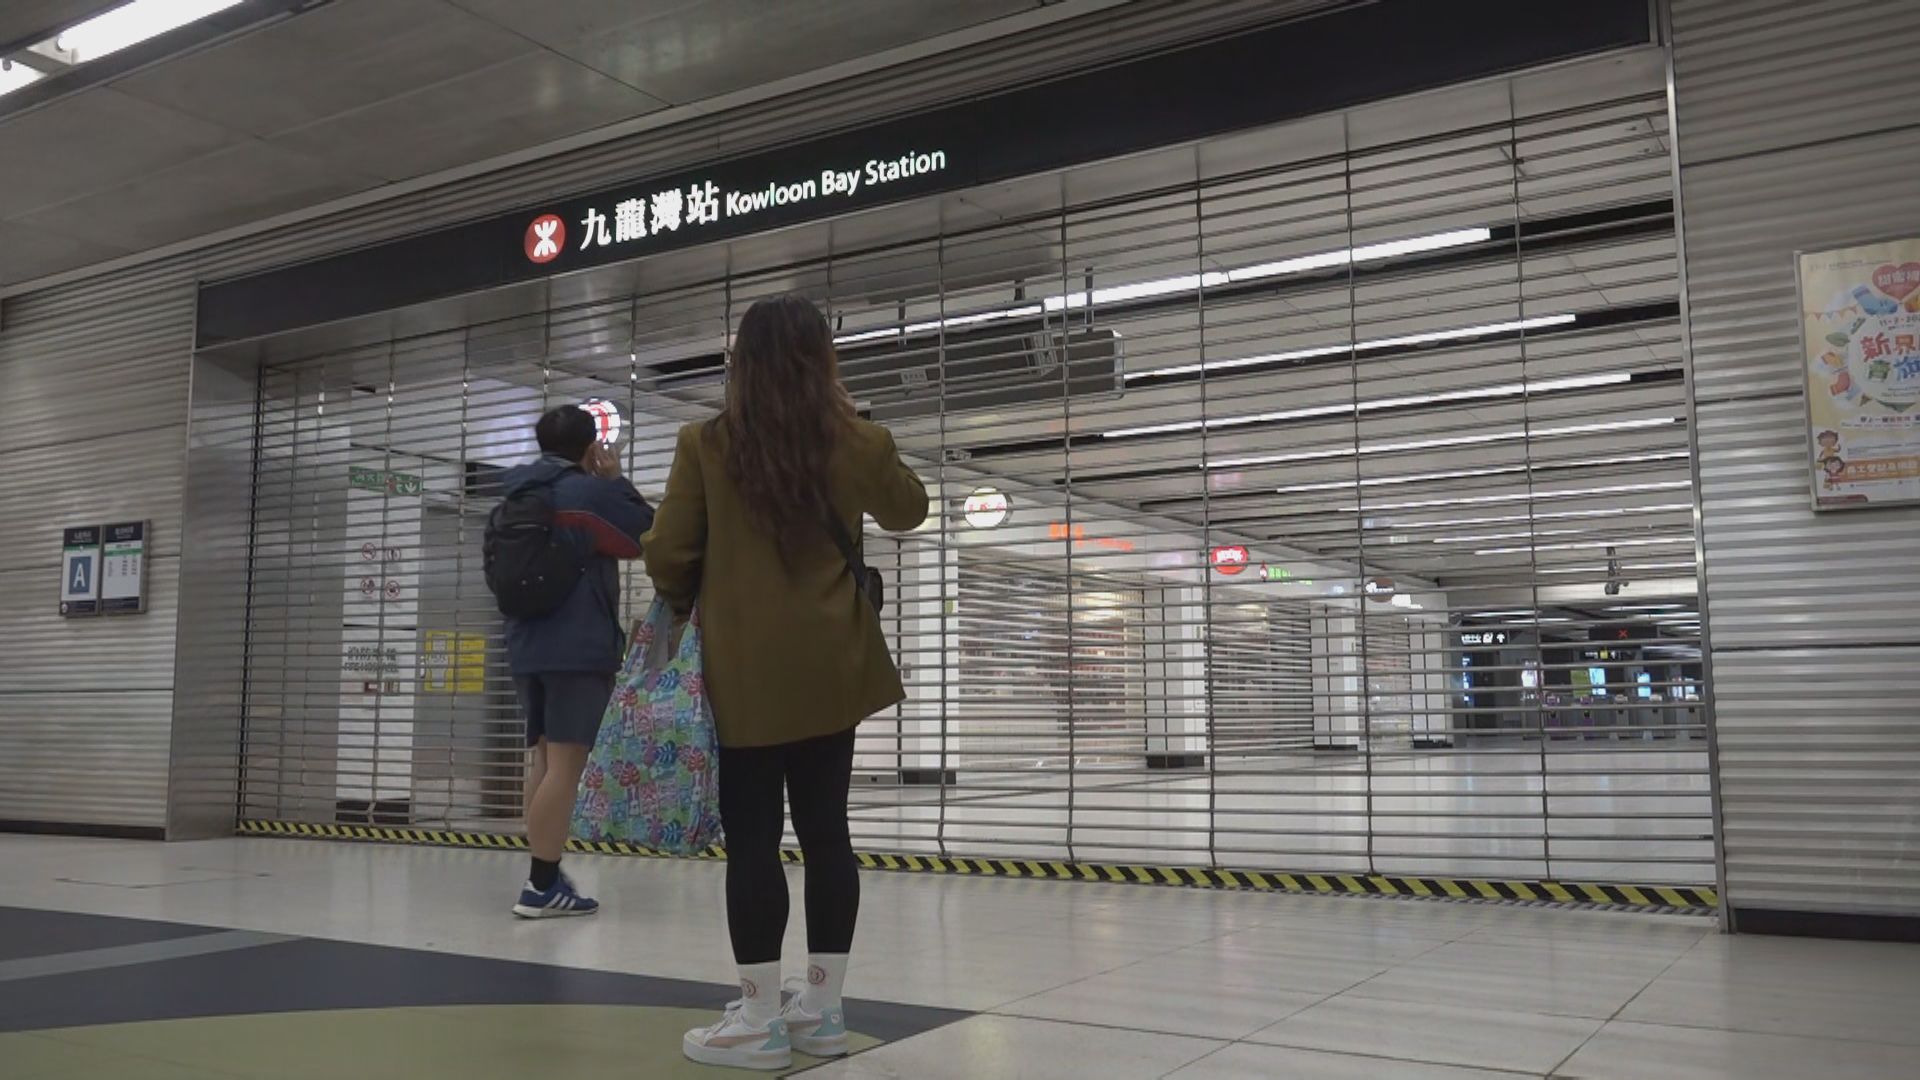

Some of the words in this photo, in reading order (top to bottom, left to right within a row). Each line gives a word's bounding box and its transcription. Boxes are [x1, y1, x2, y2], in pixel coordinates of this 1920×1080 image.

[580, 181, 720, 250] 九龍灣站
[726, 182, 816, 217] Kowloon
[821, 170, 860, 196] Bay
[865, 150, 945, 186] Station
[1860, 332, 1920, 362] 新界
[73, 562, 86, 588] A
